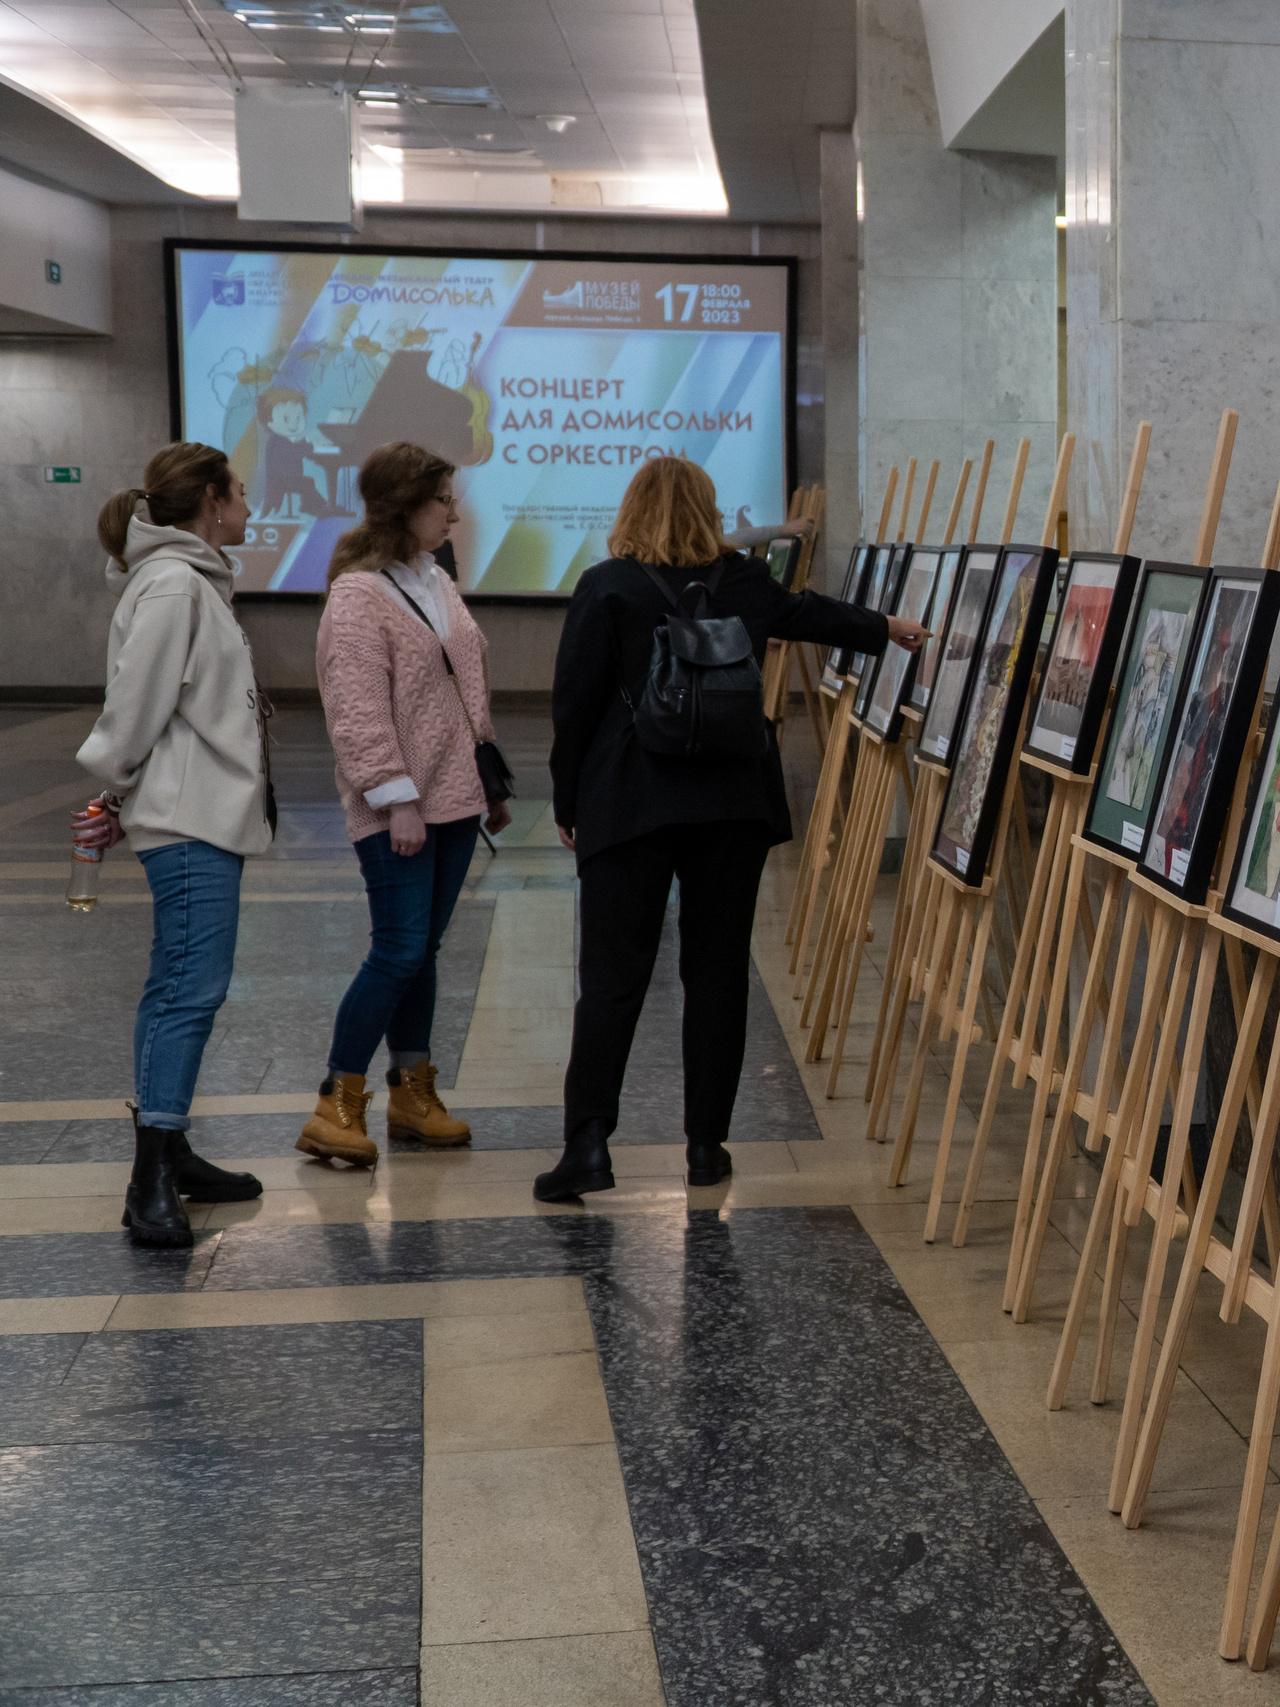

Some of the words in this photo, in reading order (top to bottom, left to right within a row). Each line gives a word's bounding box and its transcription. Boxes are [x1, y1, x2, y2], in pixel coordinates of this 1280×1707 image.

[585, 280, 640, 296] МУЗЕЙ
[701, 284, 741, 298] 18:00
[585, 296, 640, 311] ПОБЕДЫ
[655, 282, 700, 322] 17
[701, 299, 750, 309] ФЕВРАЛЯ
[701, 309, 741, 324] 2023
[500, 377, 624, 401] КОНЦЕРТ
[501, 409, 553, 432] ДЛЯ
[562, 409, 752, 433] ДОМИСОЛЬКИ
[502, 443, 518, 464] С
